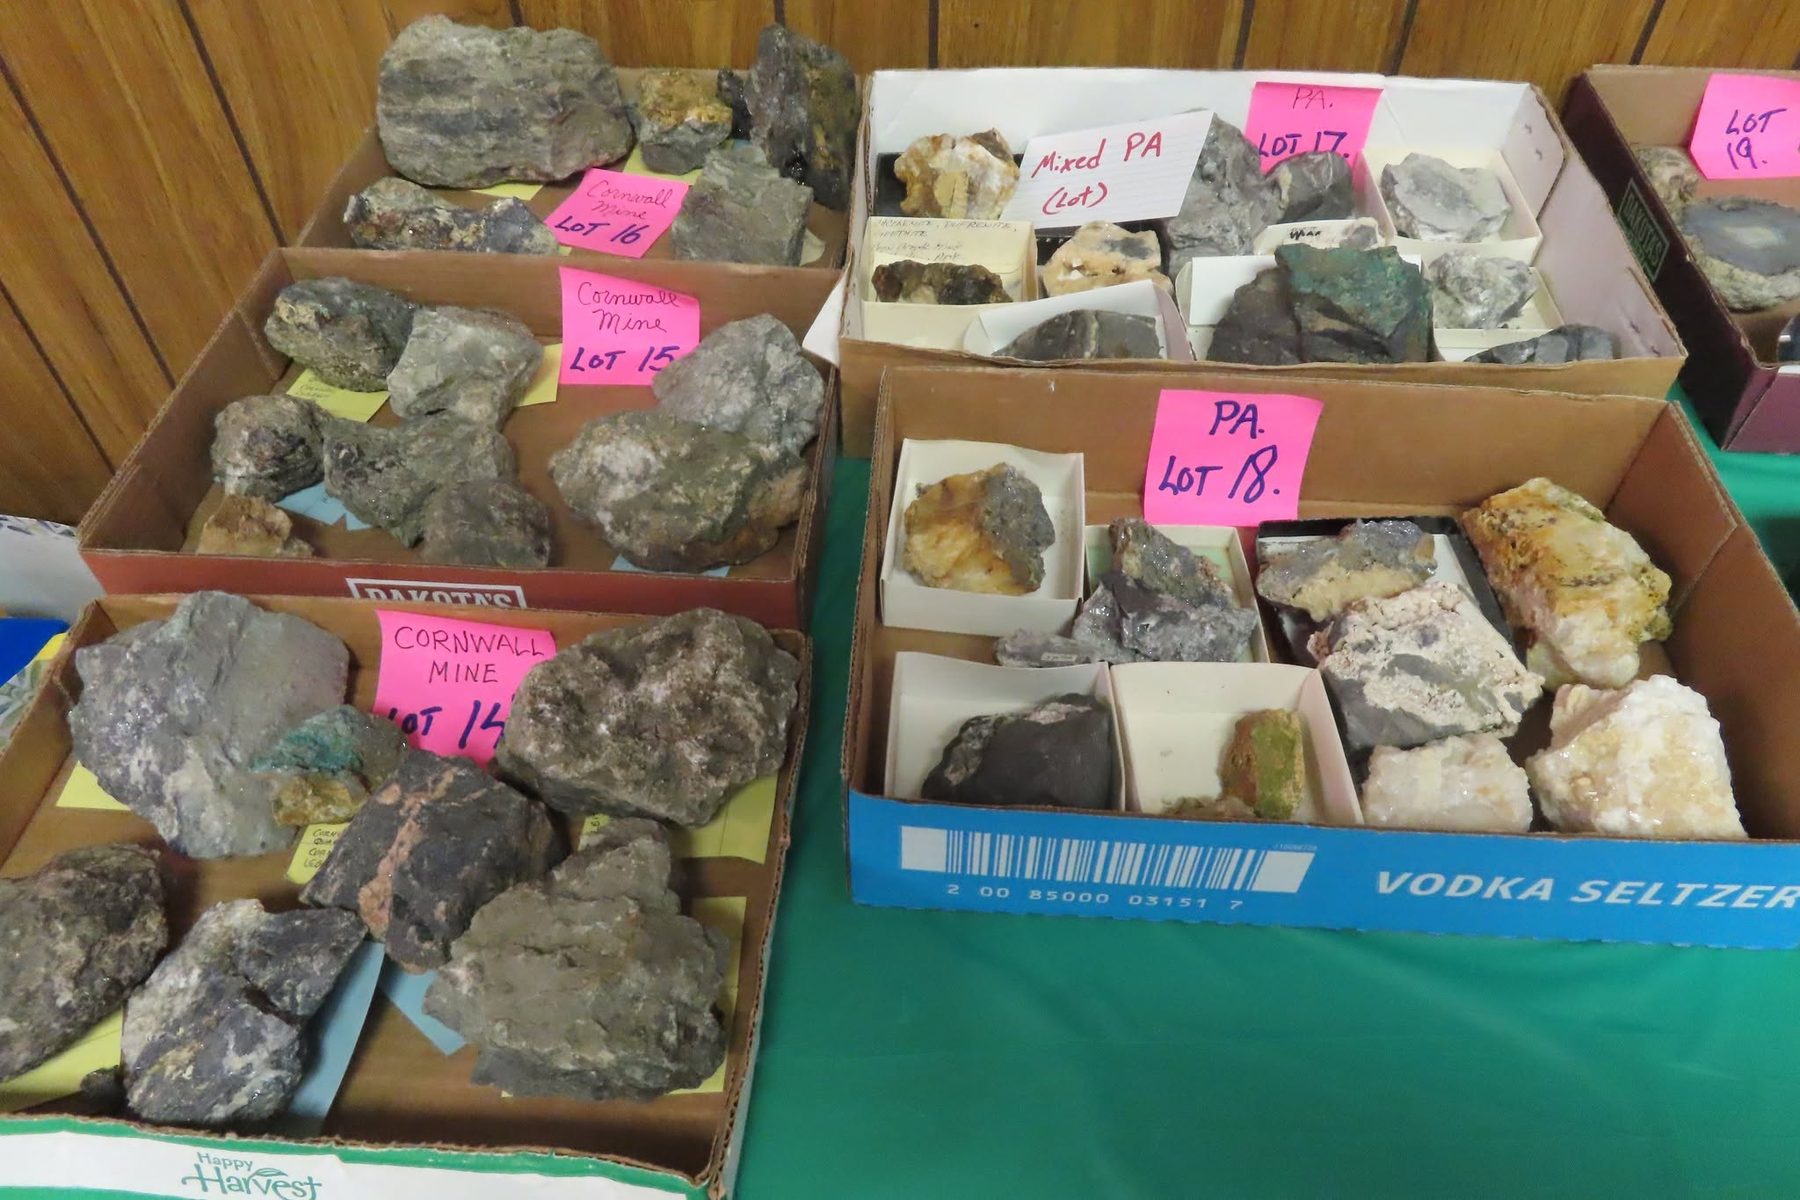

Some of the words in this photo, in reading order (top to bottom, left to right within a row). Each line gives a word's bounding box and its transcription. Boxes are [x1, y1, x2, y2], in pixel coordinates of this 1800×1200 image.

[1292, 86, 1334, 109] PA.
[1724, 108, 1788, 134] LOT
[1030, 138, 1107, 179] Mixed
[1123, 131, 1163, 163] PA
[1257, 133, 1302, 158] LOT
[586, 179, 674, 208] Cornwall
[1042, 182, 1108, 215] (Lot)
[554, 215, 611, 236] LOT
[610, 223, 650, 244] 16
[577, 281, 680, 308] Cornwall
[591, 308, 668, 335] Mine
[569, 346, 627, 372] LOT
[637, 345, 681, 372] 15
[1208, 400, 1265, 439] PA.
[1158, 455, 1224, 496] LOT
[1227, 444, 1281, 503] 18.
[394, 626, 545, 657] CORNWALL
[428, 660, 498, 684] MINE
[388, 706, 443, 737] OT
[947, 883, 960, 895] 2
[979, 886, 1010, 898] 00
[1029, 889, 1110, 904] 85000
[1128, 895, 1208, 908] 03151
[1229, 900, 1244, 910] 7
[1378, 871, 1555, 901] VODKA
[1570, 880, 1800, 908] SELTZER
[196, 1151, 254, 1172] Happy
[181, 1162, 322, 1200] Harvest
